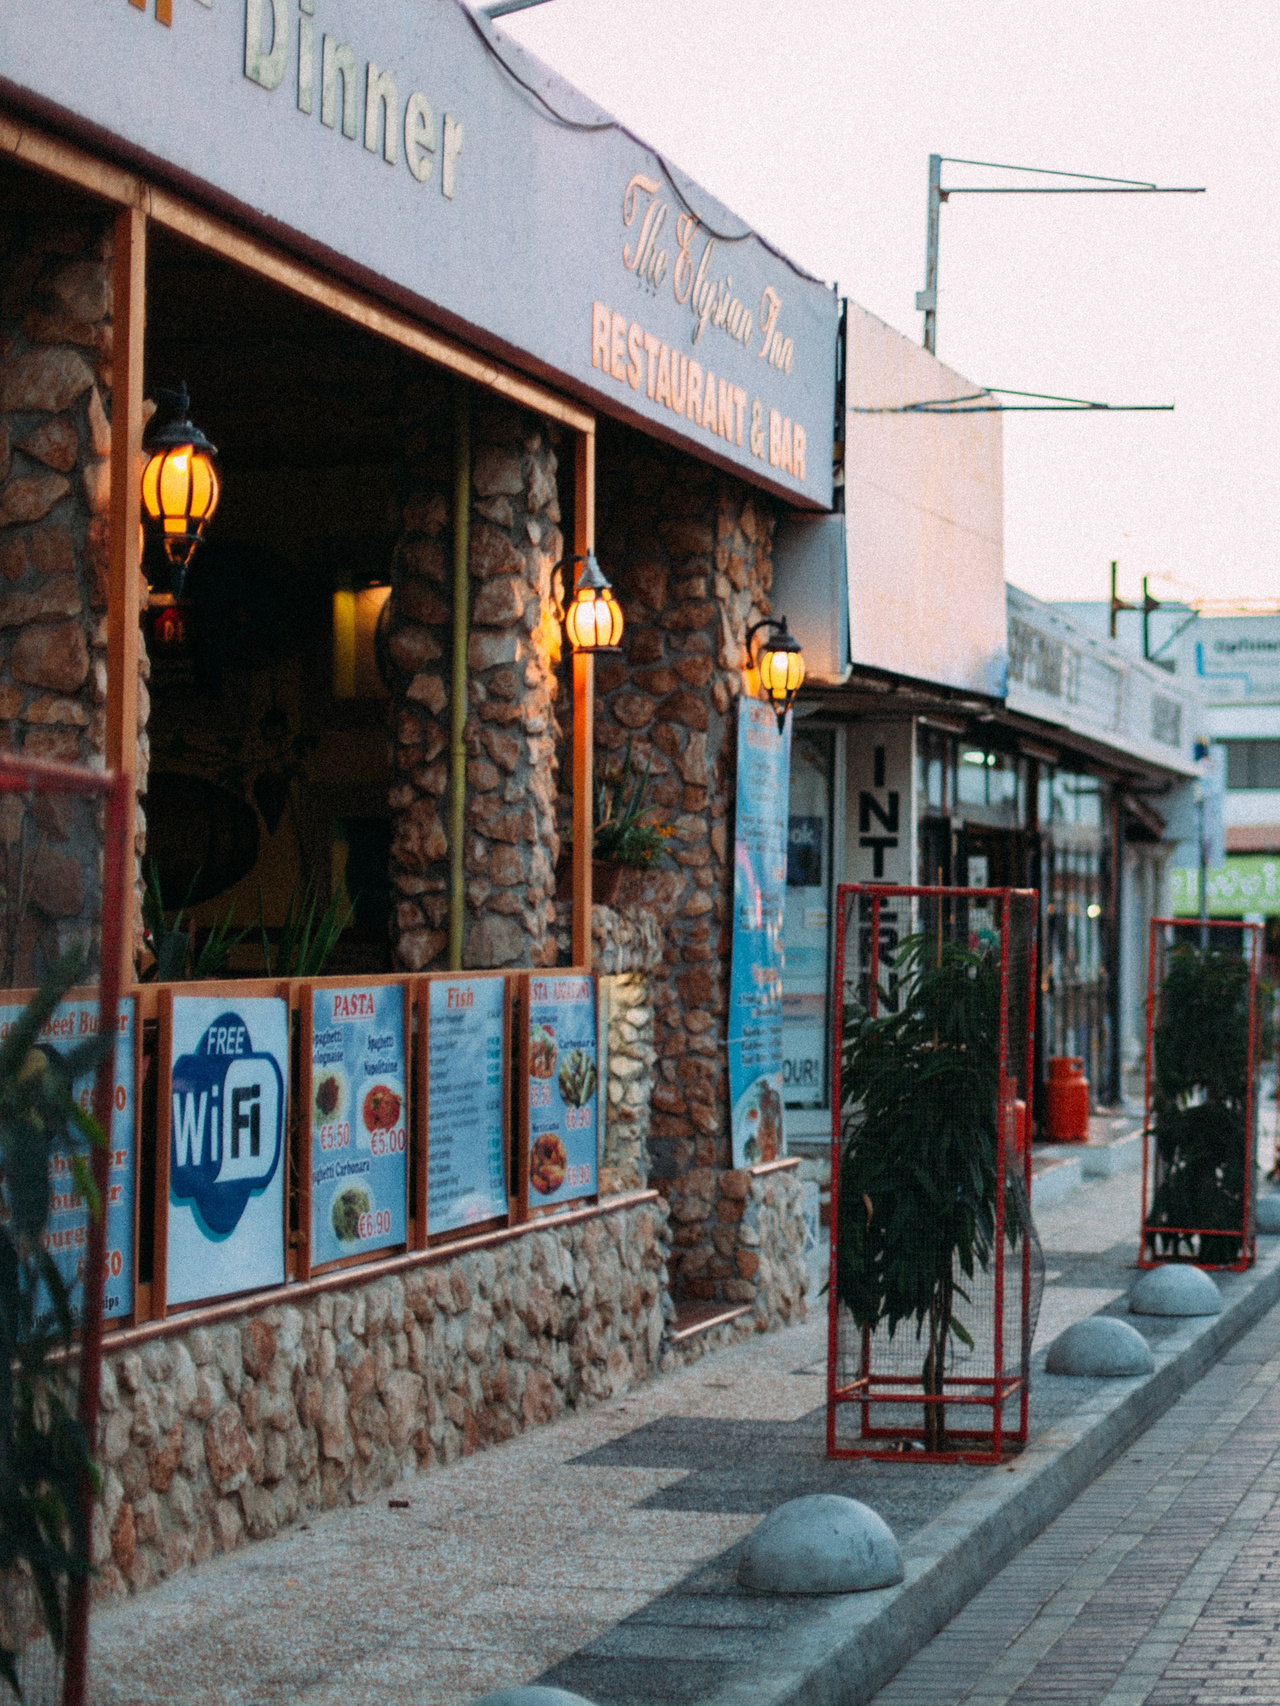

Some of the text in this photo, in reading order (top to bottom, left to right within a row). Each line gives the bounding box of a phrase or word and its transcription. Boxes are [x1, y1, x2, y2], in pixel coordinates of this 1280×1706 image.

[244, 0, 463, 200] Dinner
[623, 174, 668, 290] The
[591, 301, 806, 481] RESTAURANT & BAR
[333, 993, 374, 1017] PASTA
[447, 986, 475, 1009] Fish
[207, 1027, 245, 1055] FREE
[314, 1029, 343, 1048] paghetti
[313, 1050, 344, 1067] olognaise
[321, 1122, 350, 1150] €5.50
[371, 1128, 406, 1155] €5.00
[359, 1210, 391, 1239] €6.90
